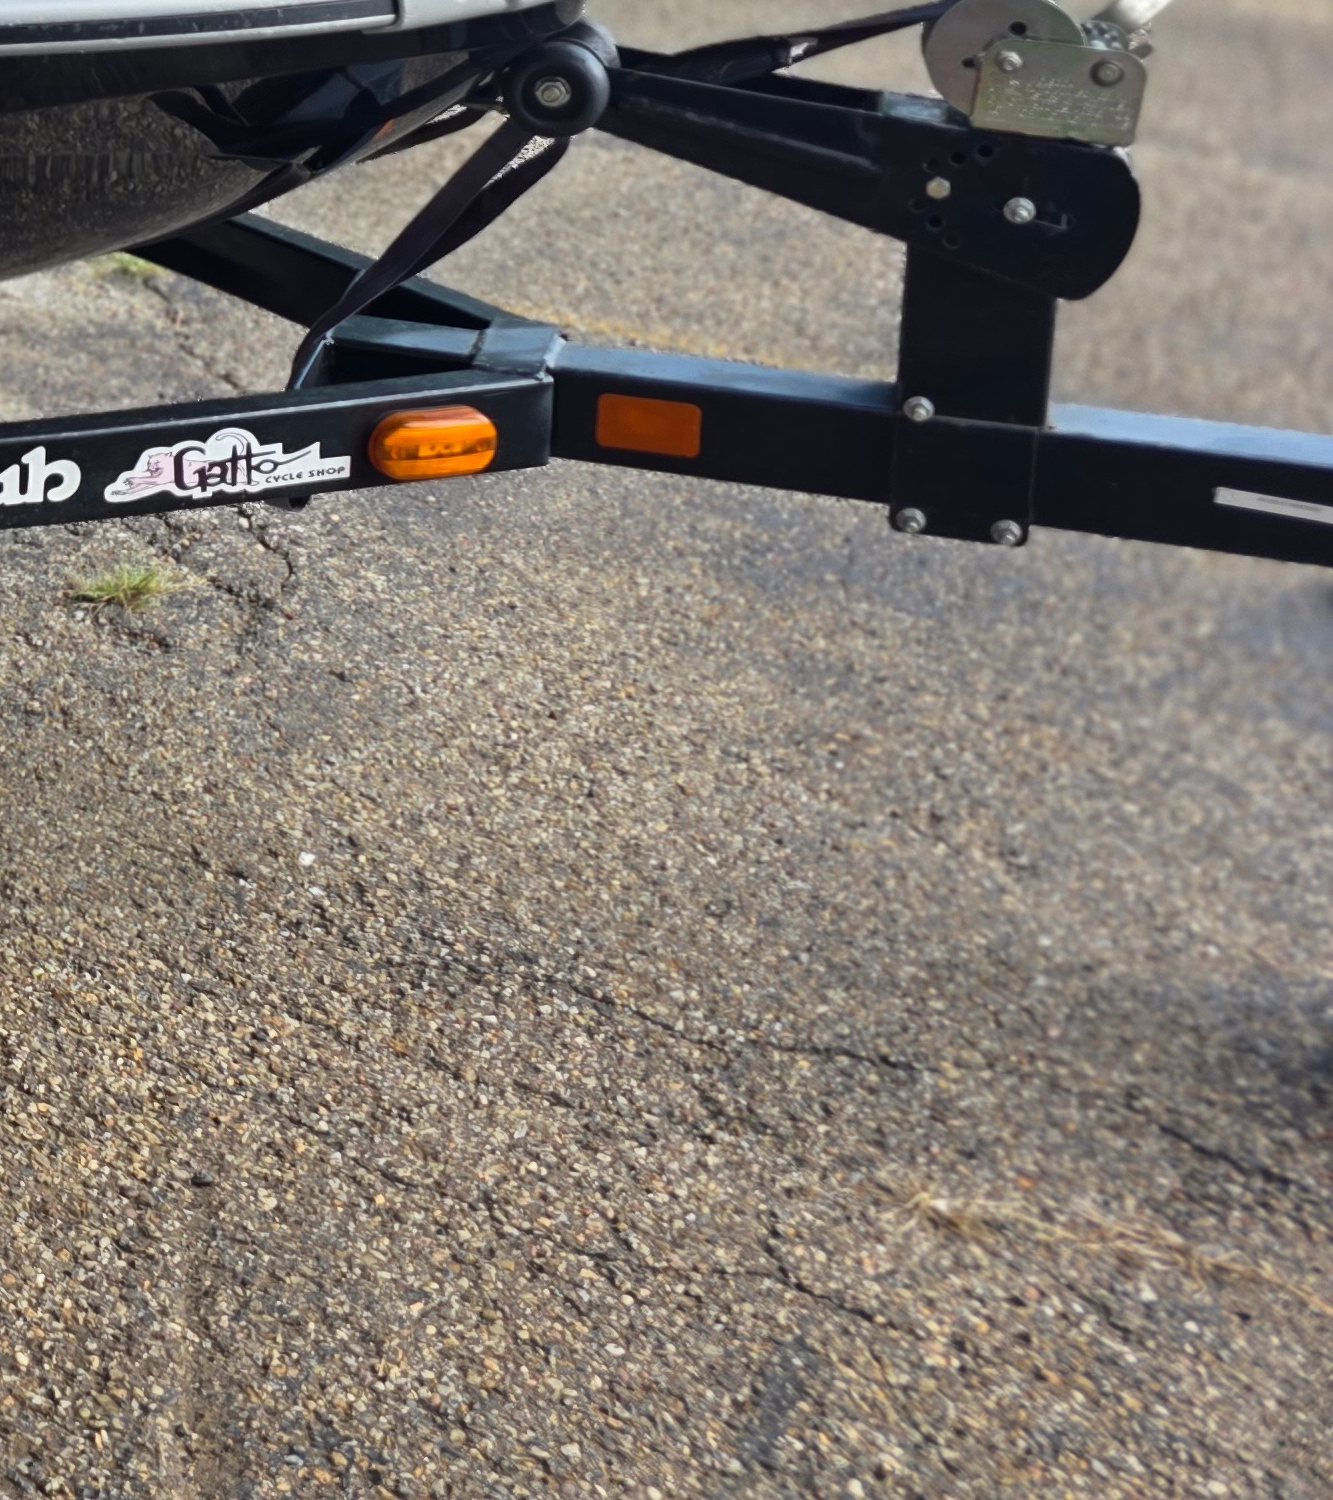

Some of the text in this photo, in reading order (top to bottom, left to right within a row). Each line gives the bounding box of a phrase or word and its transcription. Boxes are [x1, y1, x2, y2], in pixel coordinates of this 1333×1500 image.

[173, 441, 311, 493] Gatto
[265, 466, 346, 484] CYCLE SHOP
